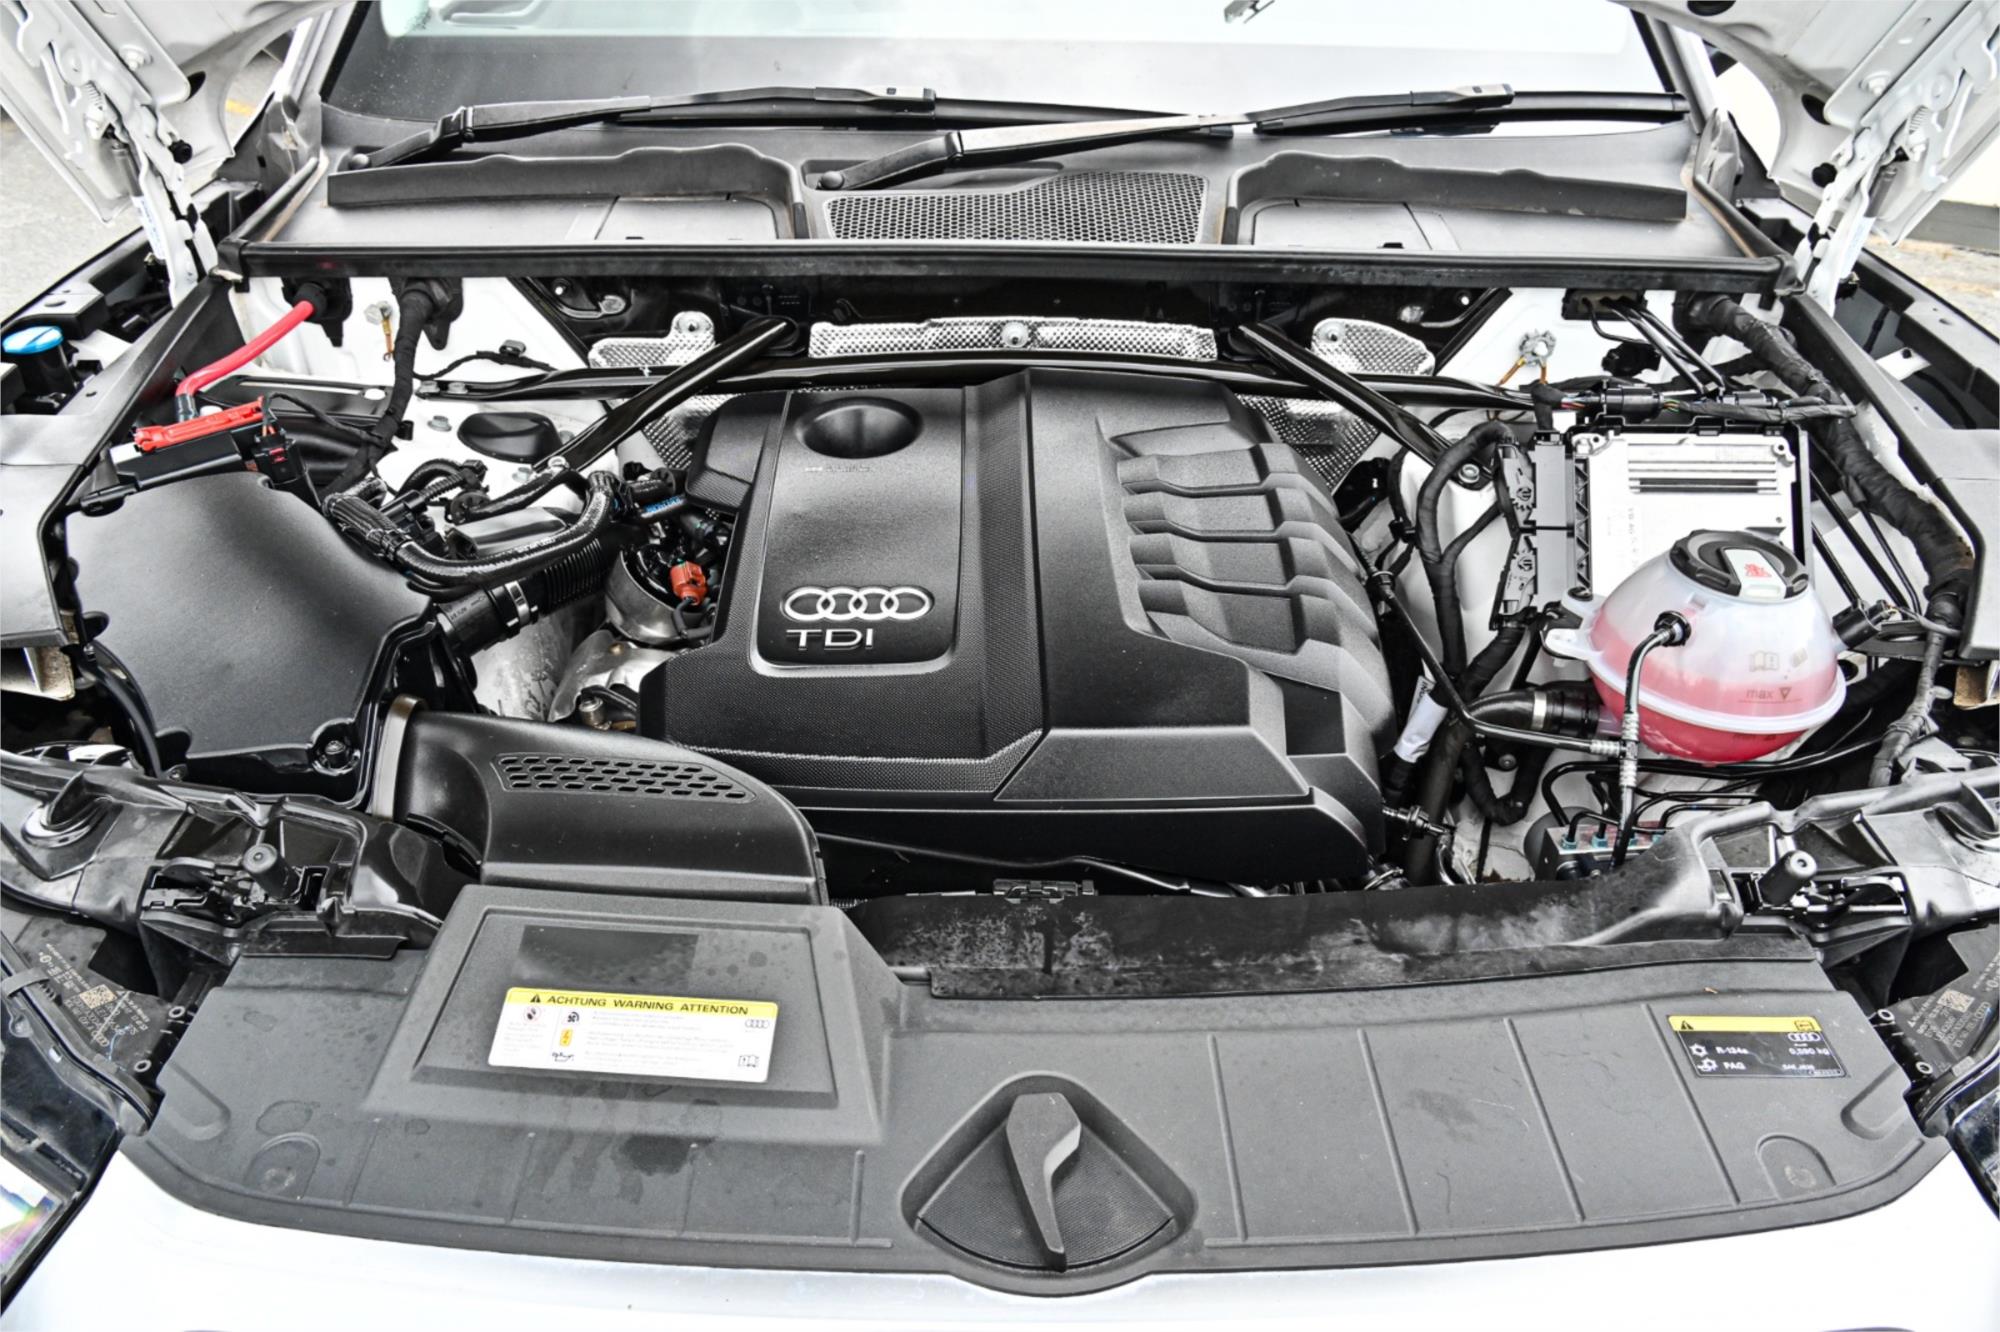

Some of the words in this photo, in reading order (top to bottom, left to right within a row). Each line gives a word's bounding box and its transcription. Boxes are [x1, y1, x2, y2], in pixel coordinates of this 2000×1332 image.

[786, 628, 874, 648] TDI
[1746, 688, 1774, 699] max
[547, 995, 607, 1007] ACHTUNG
[613, 999, 674, 1011] WARNING
[680, 1003, 749, 1016] ATTENTION
[1723, 1061, 1746, 1070] PAG
